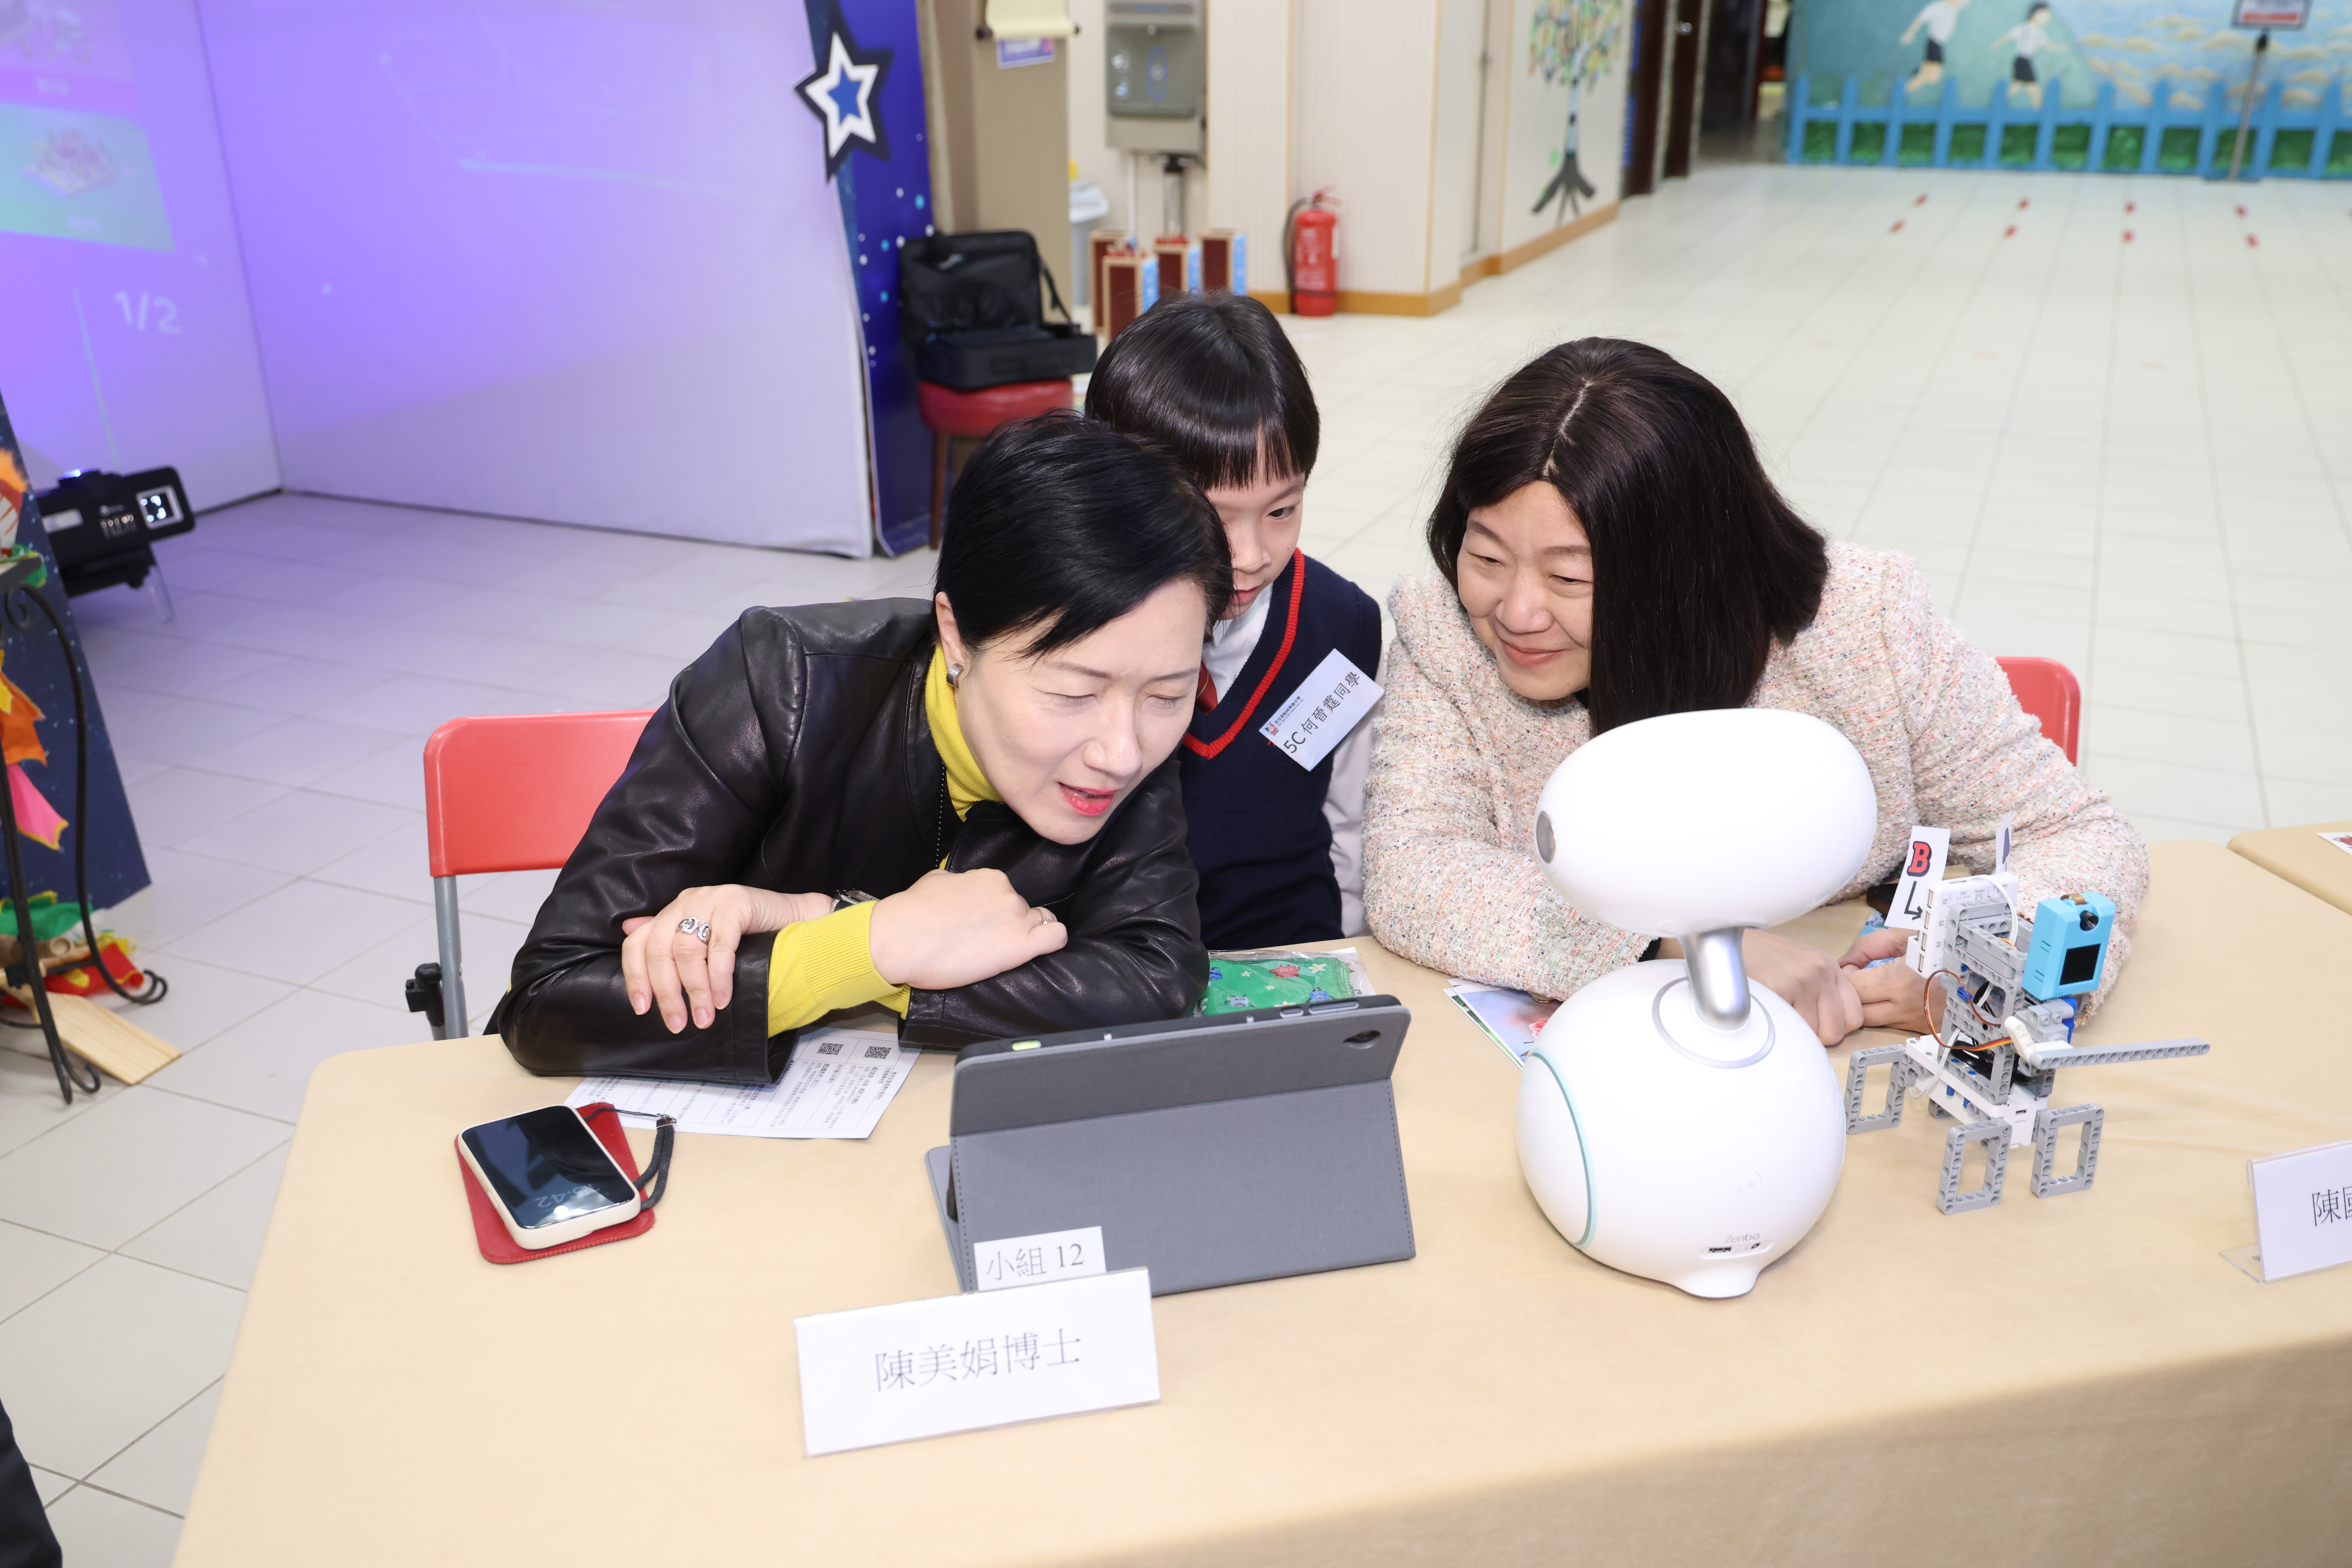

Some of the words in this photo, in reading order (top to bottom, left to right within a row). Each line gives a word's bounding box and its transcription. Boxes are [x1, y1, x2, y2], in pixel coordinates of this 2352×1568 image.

[114, 290, 183, 335] 1/2
[1907, 841, 1932, 877] B
[1725, 1233, 1760, 1243] Zenbo
[985, 1247, 1047, 1281] 小組
[1057, 1243, 1084, 1268] 12
[876, 1328, 1082, 1392] 陳美娟博士
